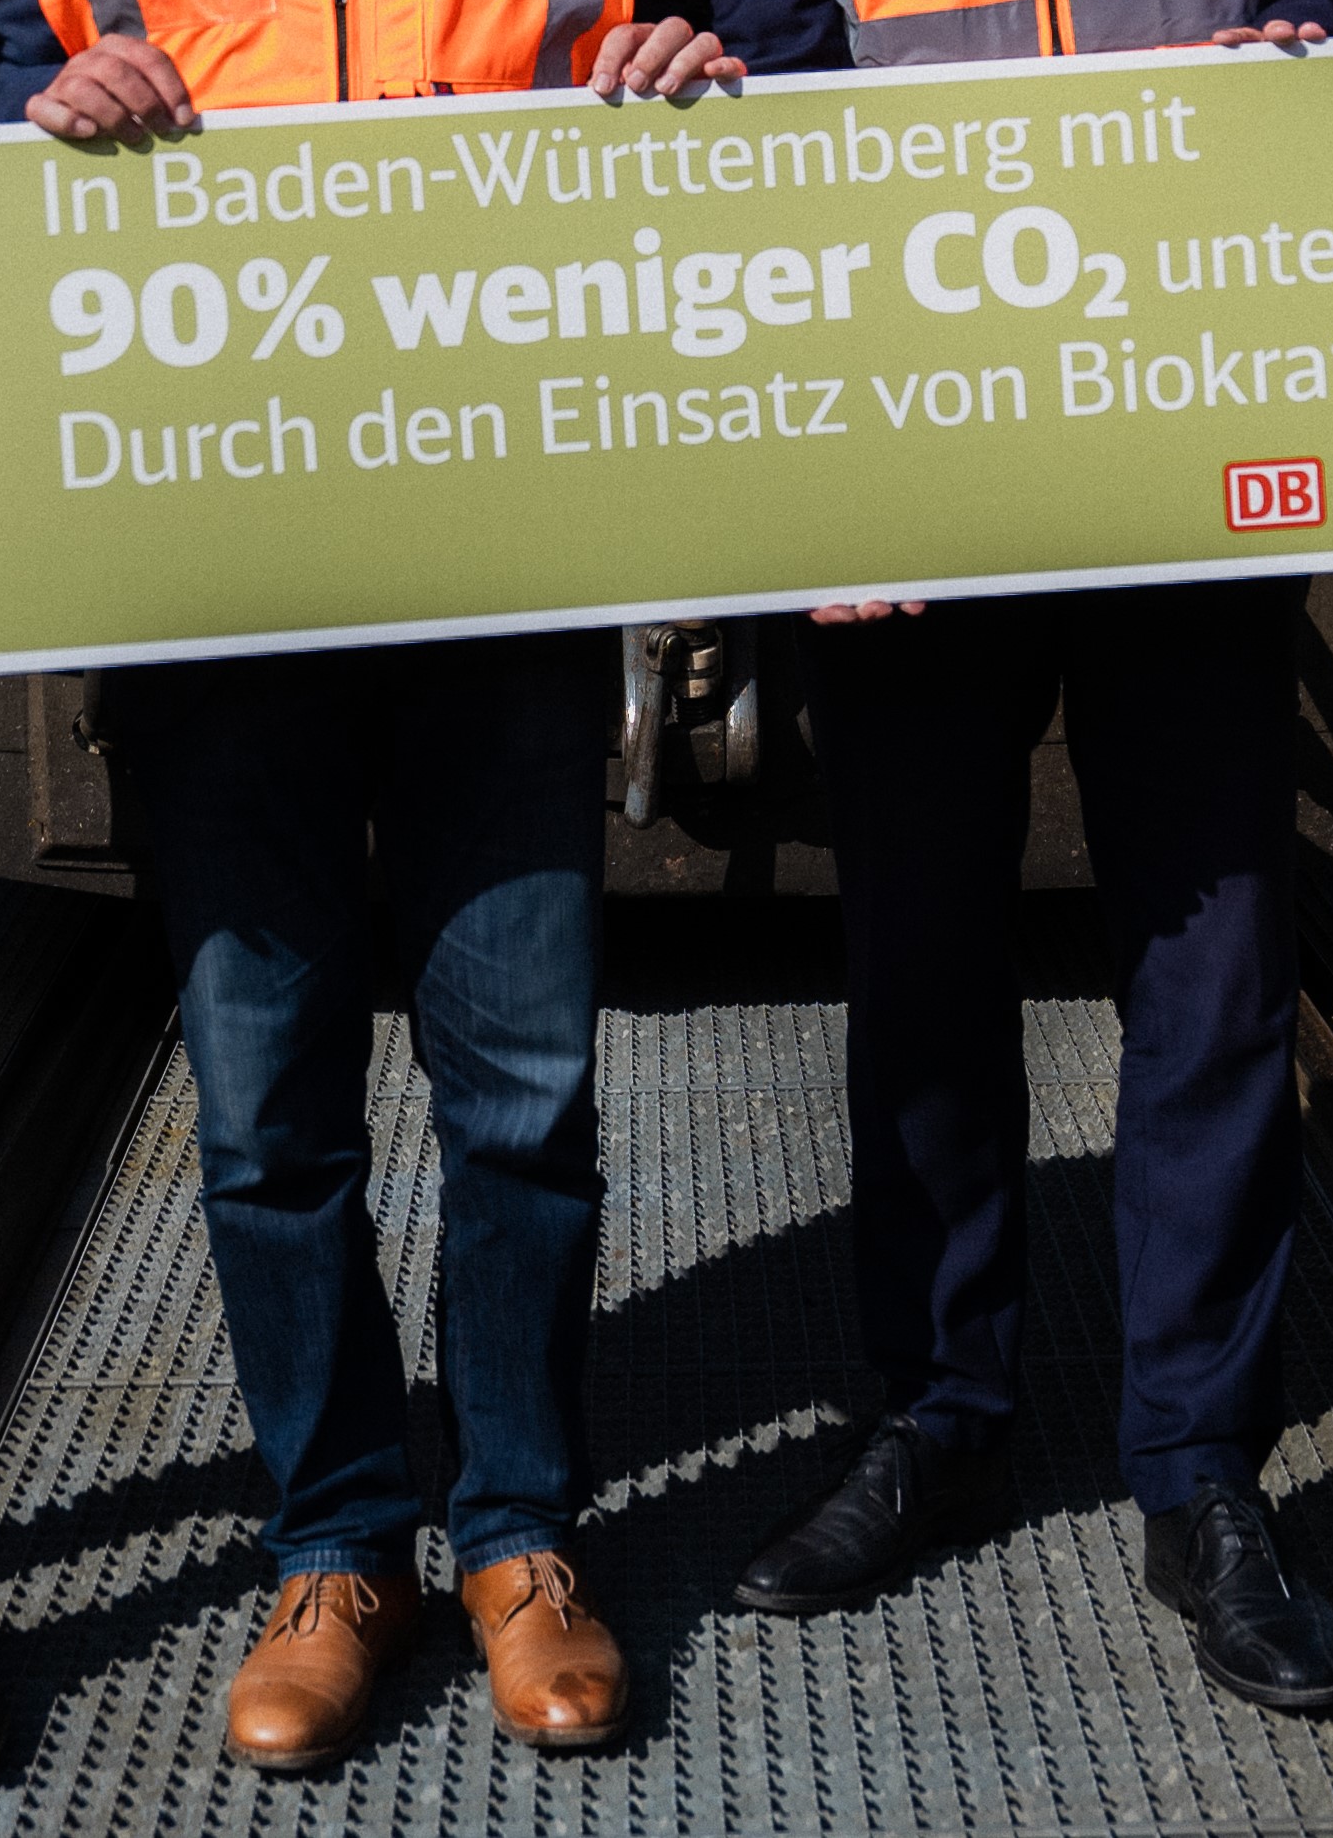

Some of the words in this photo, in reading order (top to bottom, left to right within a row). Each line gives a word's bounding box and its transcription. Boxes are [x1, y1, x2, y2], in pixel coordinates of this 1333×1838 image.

[43, 157, 120, 236] In
[153, 106, 1034, 229] Baden-Württemberg
[1059, 88, 1201, 168] mit
[49, 255, 346, 376] 90%
[371, 226, 872, 358] weniger
[59, 396, 318, 489] Durch
[348, 388, 508, 470] den
[538, 371, 848, 455] Einsatz
[871, 366, 1028, 430] von
[1237, 471, 1313, 520] DB
